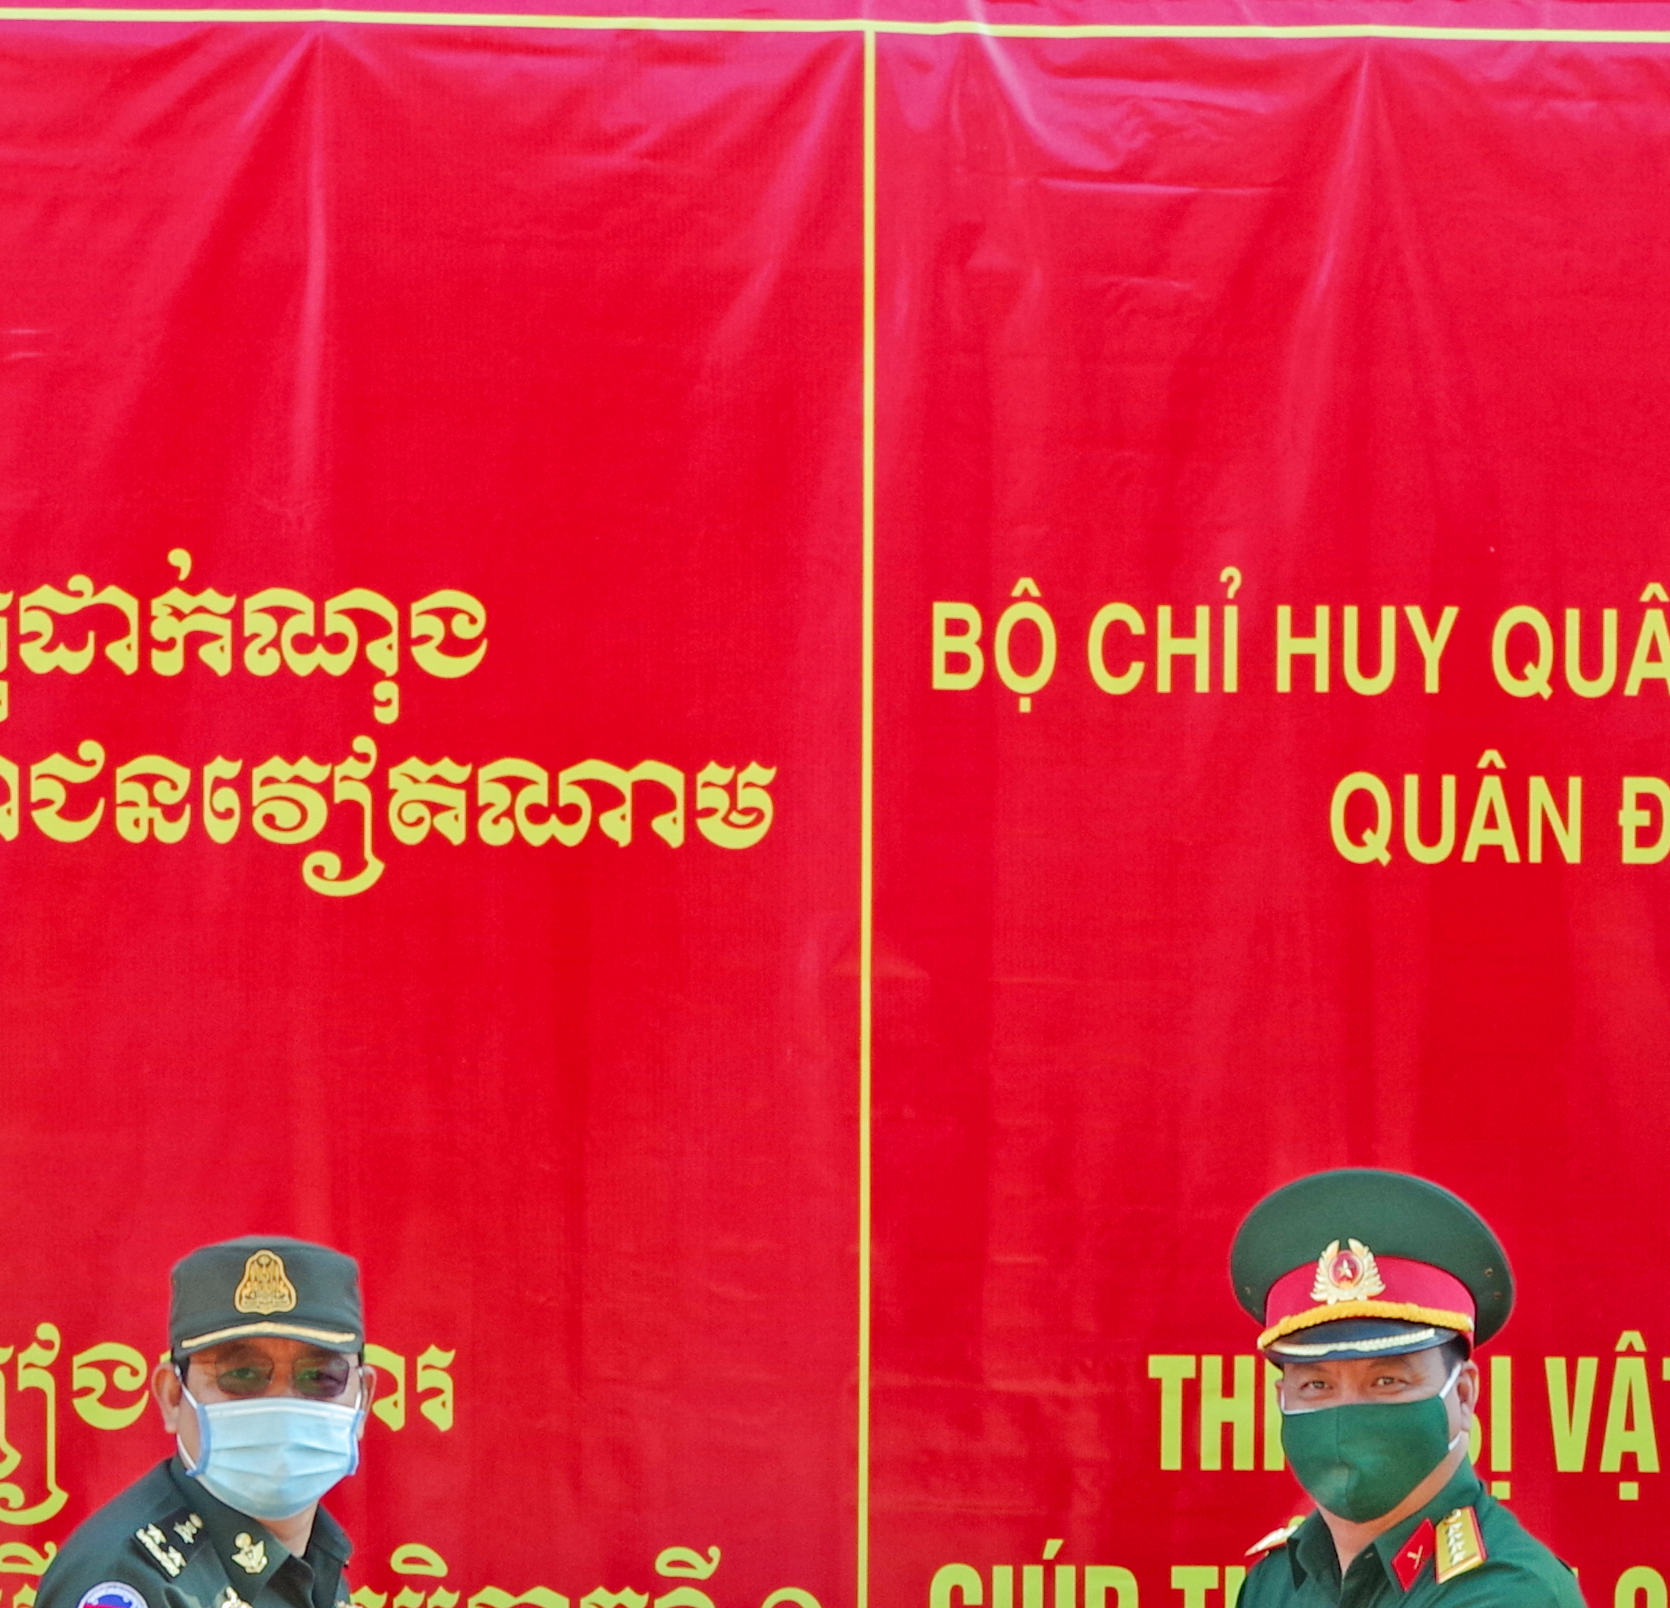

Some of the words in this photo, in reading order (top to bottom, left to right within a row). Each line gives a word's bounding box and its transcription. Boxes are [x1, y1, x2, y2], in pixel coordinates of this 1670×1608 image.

[931, 577, 1057, 712] BỘ
[1087, 566, 1242, 696] CHỈ
[1276, 604, 1459, 696] HUY
[1329, 749, 1583, 867] QUÂN
